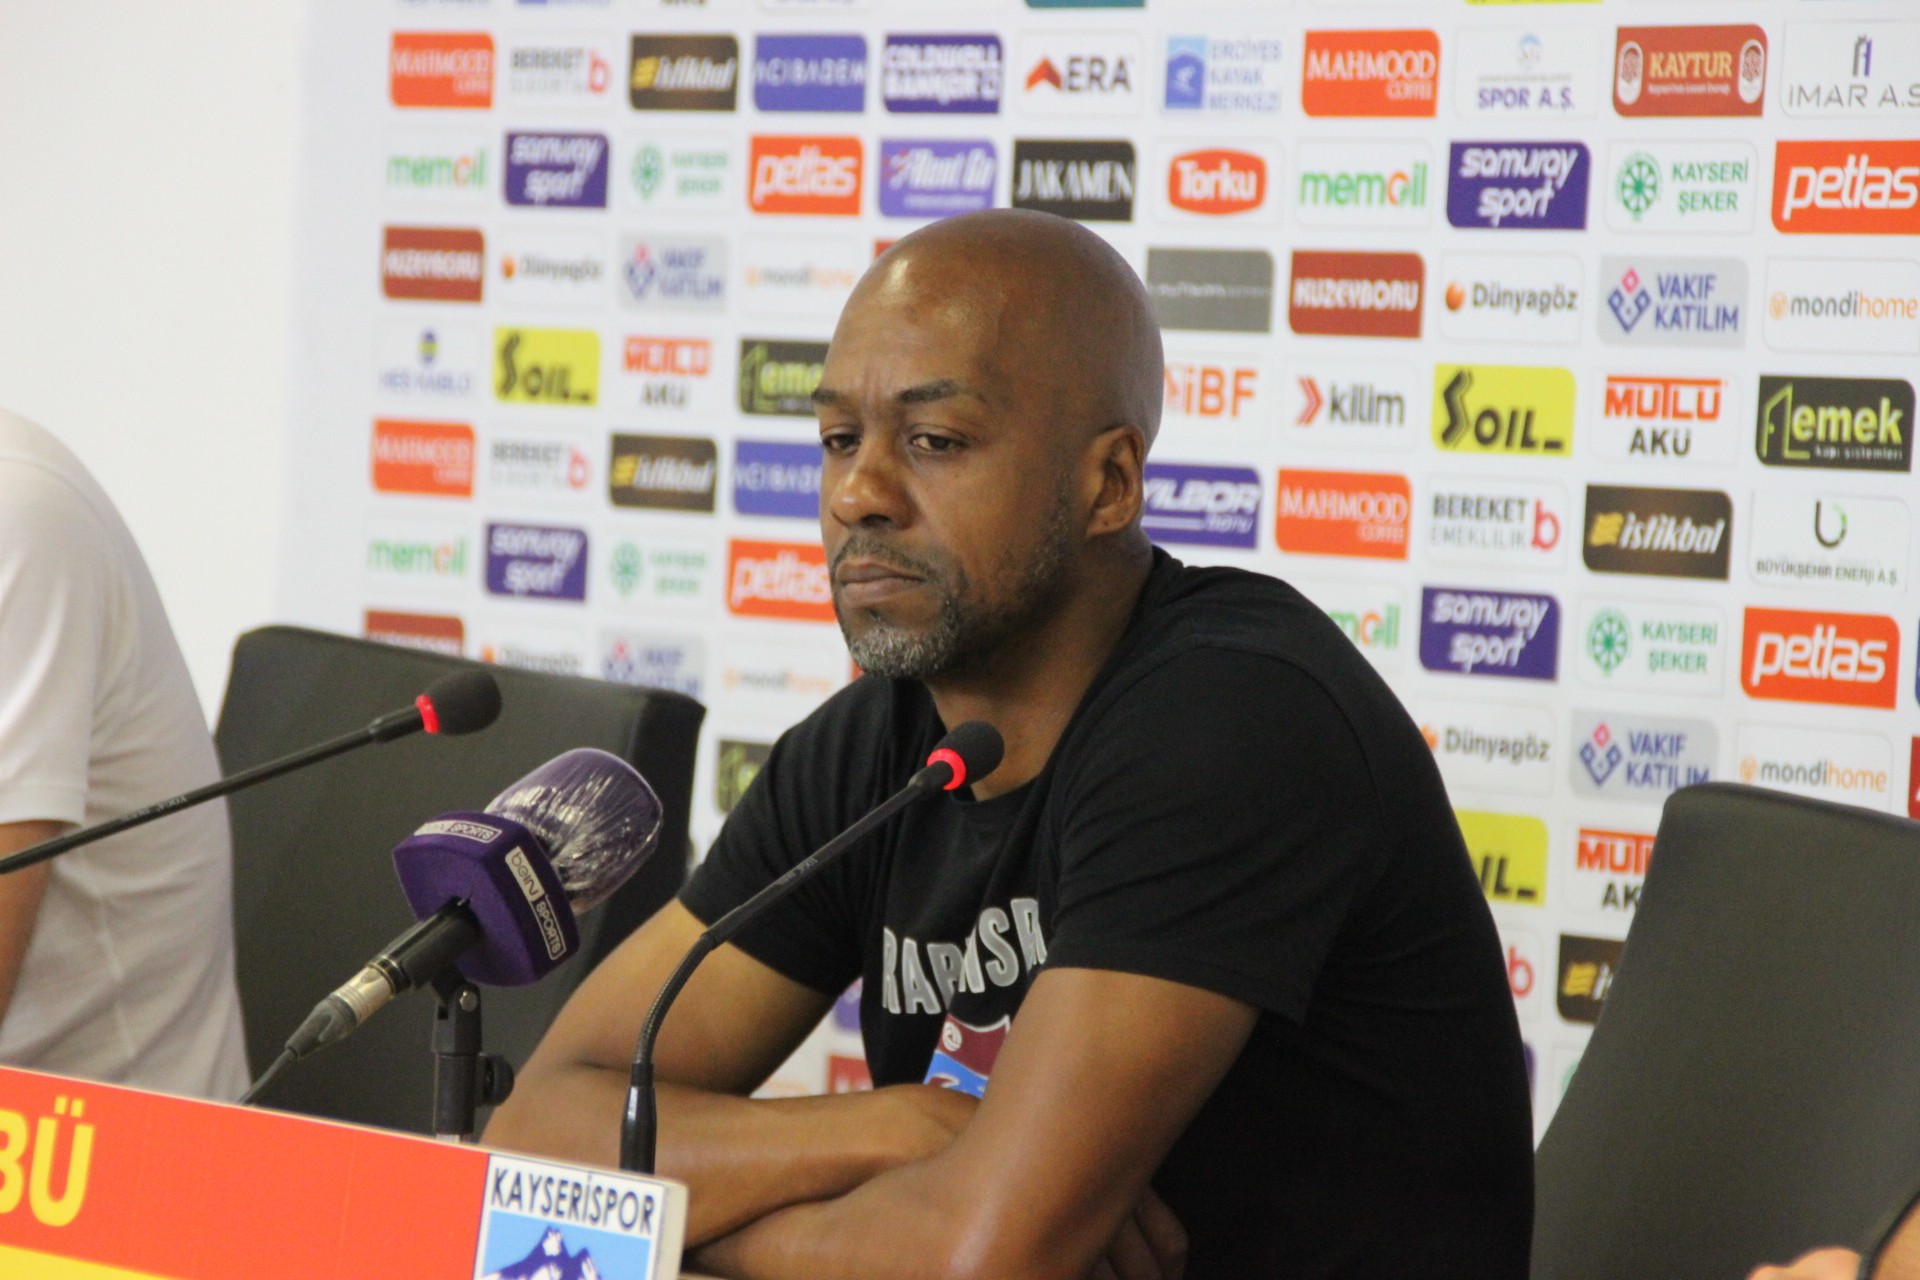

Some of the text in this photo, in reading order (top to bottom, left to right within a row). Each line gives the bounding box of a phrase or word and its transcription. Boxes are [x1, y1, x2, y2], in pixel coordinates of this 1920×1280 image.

[1065, 58, 1131, 92] ERA
[1307, 50, 1436, 80] MAHMOOD
[1649, 51, 1733, 78] KAYTUR
[1478, 86, 1530, 110] SPOR
[509, 135, 604, 175] samuray
[1459, 148, 1578, 189] samuray
[1672, 158, 1749, 183] KAYSERİ
[523, 168, 590, 205] sport
[752, 145, 858, 206] petlas
[1017, 159, 1133, 199] JAKAMEN
[1176, 160, 1257, 200] Torku
[1783, 155, 1919, 221] petlas
[1477, 180, 1554, 227] sport
[1677, 191, 1739, 215] ŞEKER
[1293, 276, 1420, 312] KUZEYBORU
[1472, 281, 1578, 314] Dünyagöz
[1657, 272, 1716, 299] VAKIF
[1654, 302, 1739, 331] KATILIM
[1789, 292, 1918, 322] mondihome
[1329, 383, 1405, 425] kilim
[1604, 374, 1722, 421] MUTLU
[1792, 396, 1904, 445] emek
[1628, 428, 1692, 457] AKÜ
[1280, 488, 1408, 523] MAHMOOD
[1433, 494, 1529, 522] BEREKET
[1619, 511, 1725, 555] istikbal
[1431, 592, 1550, 640] samuray
[1642, 621, 1718, 646] KAYSERİ
[1449, 618, 1526, 674] sport
[1647, 650, 1708, 674] ŞEKER
[1751, 624, 1888, 687] petlas
[1444, 728, 1550, 764] Dünyagöz
[1628, 730, 1686, 758] VAKIF
[1760, 760, 1888, 792] mondihome
[490, 1166, 656, 1235] KAYSERİSPOR
